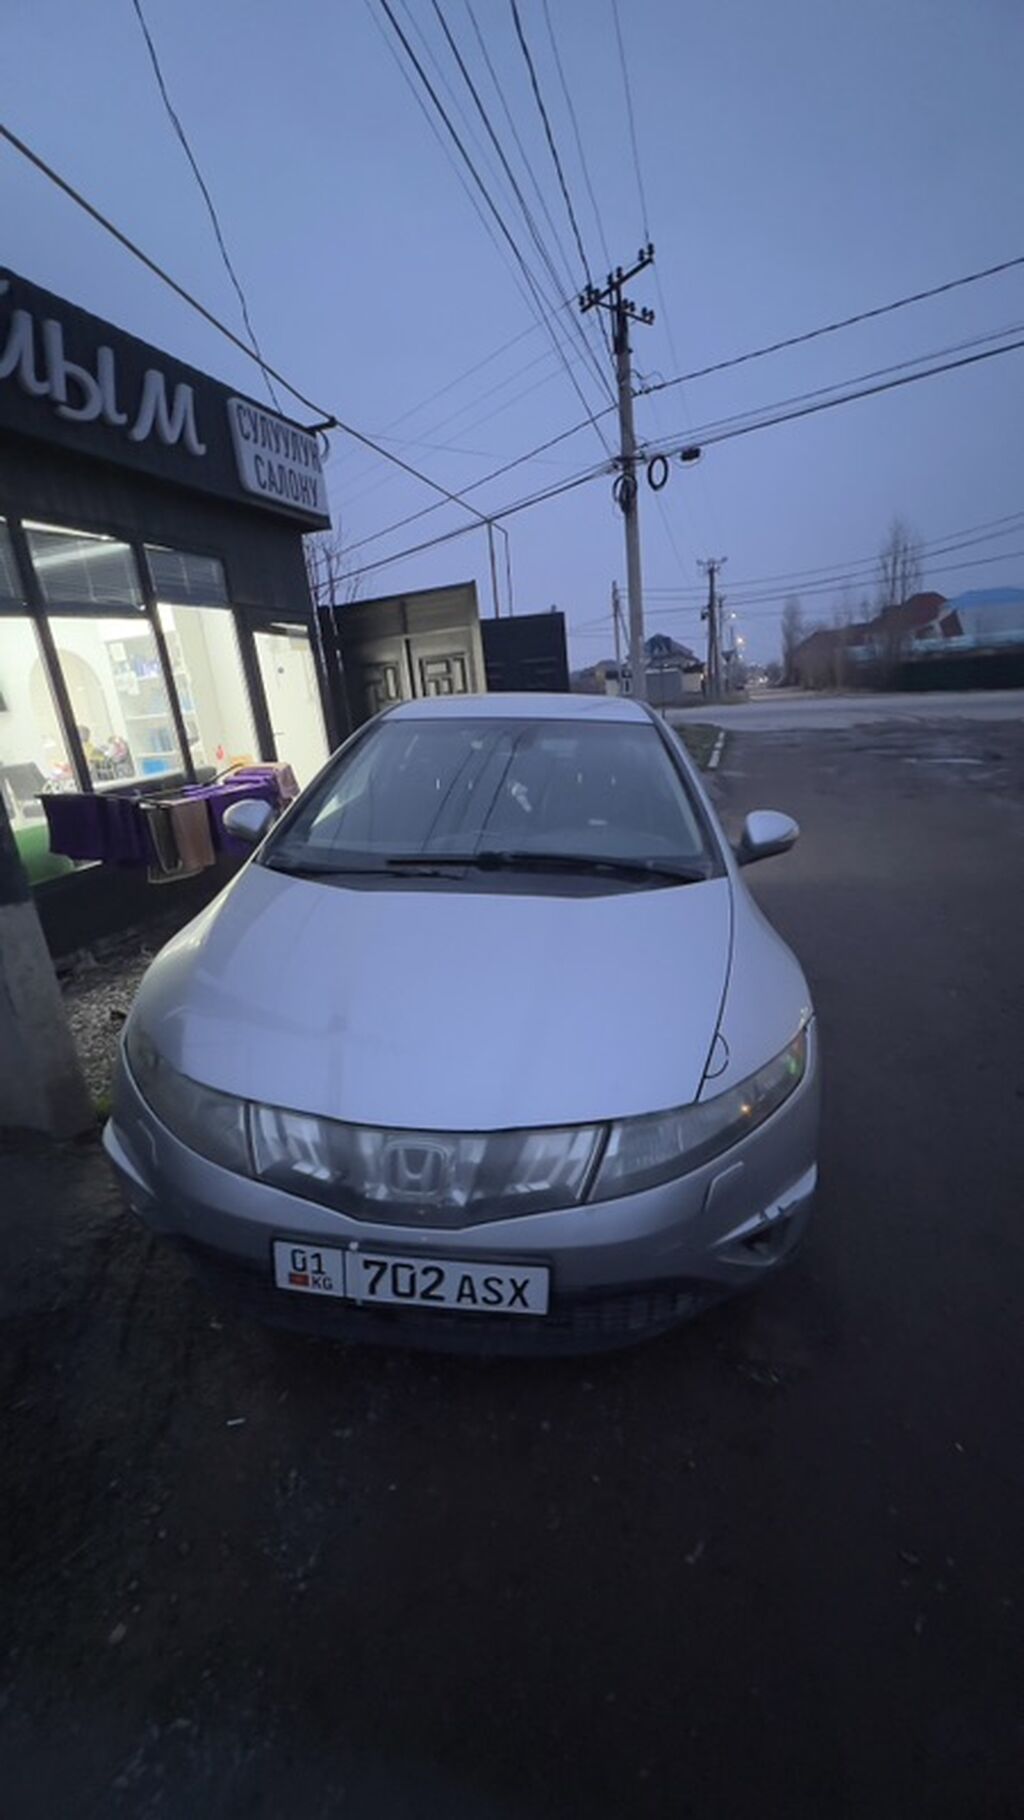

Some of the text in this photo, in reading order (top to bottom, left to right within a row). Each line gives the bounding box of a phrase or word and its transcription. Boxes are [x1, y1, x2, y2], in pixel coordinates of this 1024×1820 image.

[254, 453, 317, 507] САЛОНУ
[290, 1248, 326, 1275] 01
[311, 1275, 334, 1290] KG
[363, 1259, 529, 1308] 702 ASX
